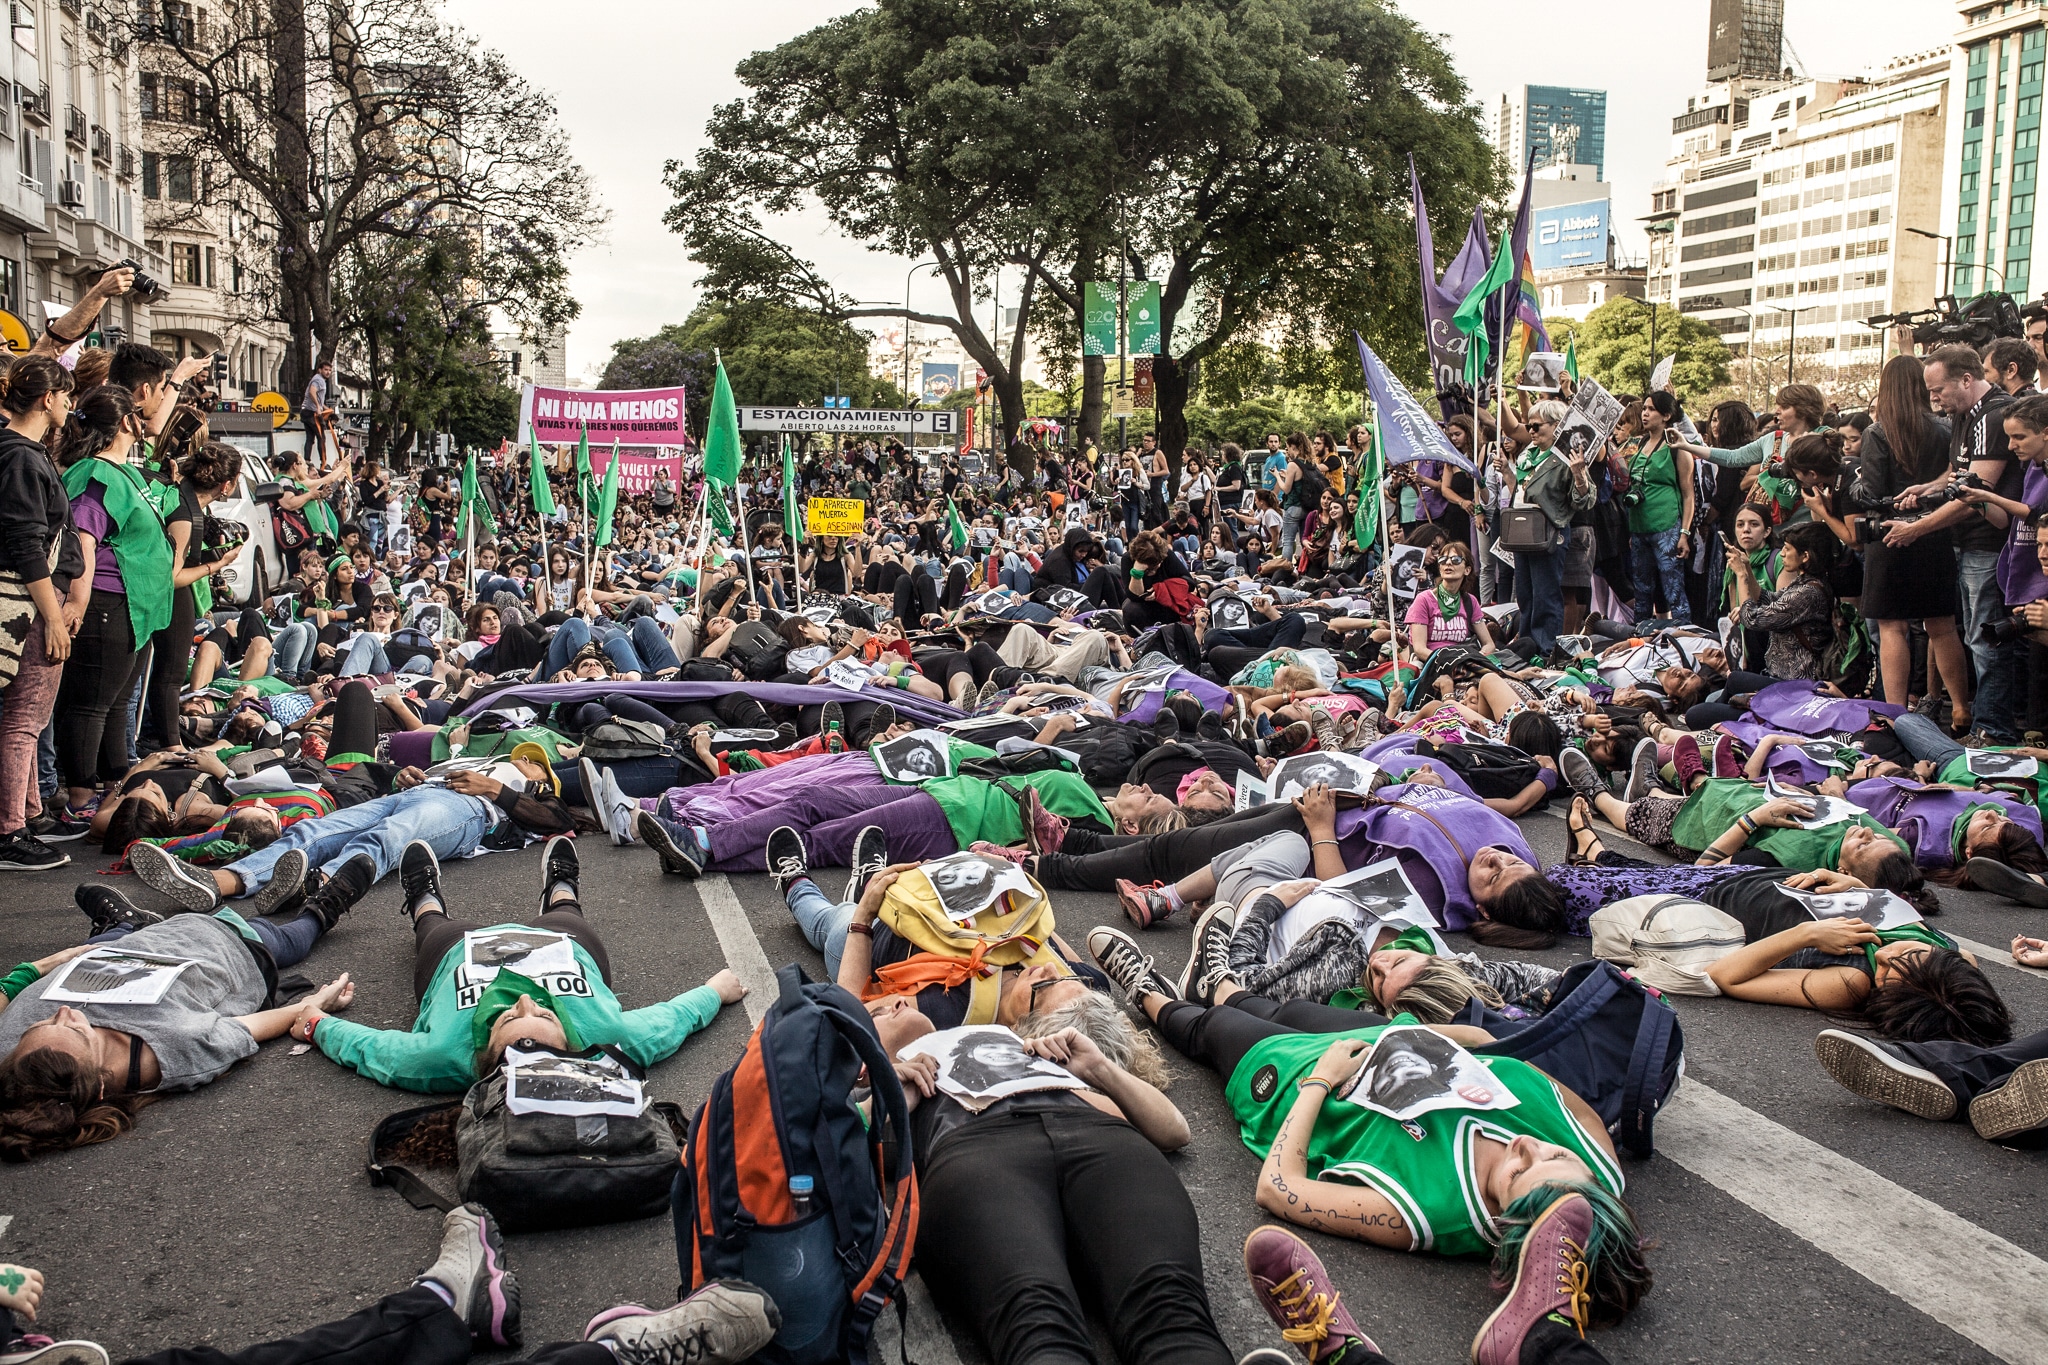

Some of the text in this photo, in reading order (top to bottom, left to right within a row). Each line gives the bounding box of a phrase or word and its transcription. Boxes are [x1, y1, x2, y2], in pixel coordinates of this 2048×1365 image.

[1562, 214, 1600, 232] Abbott
[1086, 310, 1115, 323] G20
[256, 404, 284, 413] Subte
[538, 397, 679, 420] NI UNA MENOS
[752, 409, 924, 422] ESTACIONAMIENTO
[538, 419, 678, 432] VIVAS Y LBRES NOS QUEREMOS
[780, 422, 824, 431] ABIERTO
[827, 423, 846, 431] LAS
[862, 424, 896, 432] HORAS
[936, 415, 948, 430] E
[810, 500, 818, 509] NO
[818, 510, 848, 519] MUERTAS
[809, 522, 821, 531] LAS
[1433, 616, 1467, 630] NI UNA
[1430, 630, 1466, 642] MENOS
[1256, 1079, 1272, 1096] NBA
